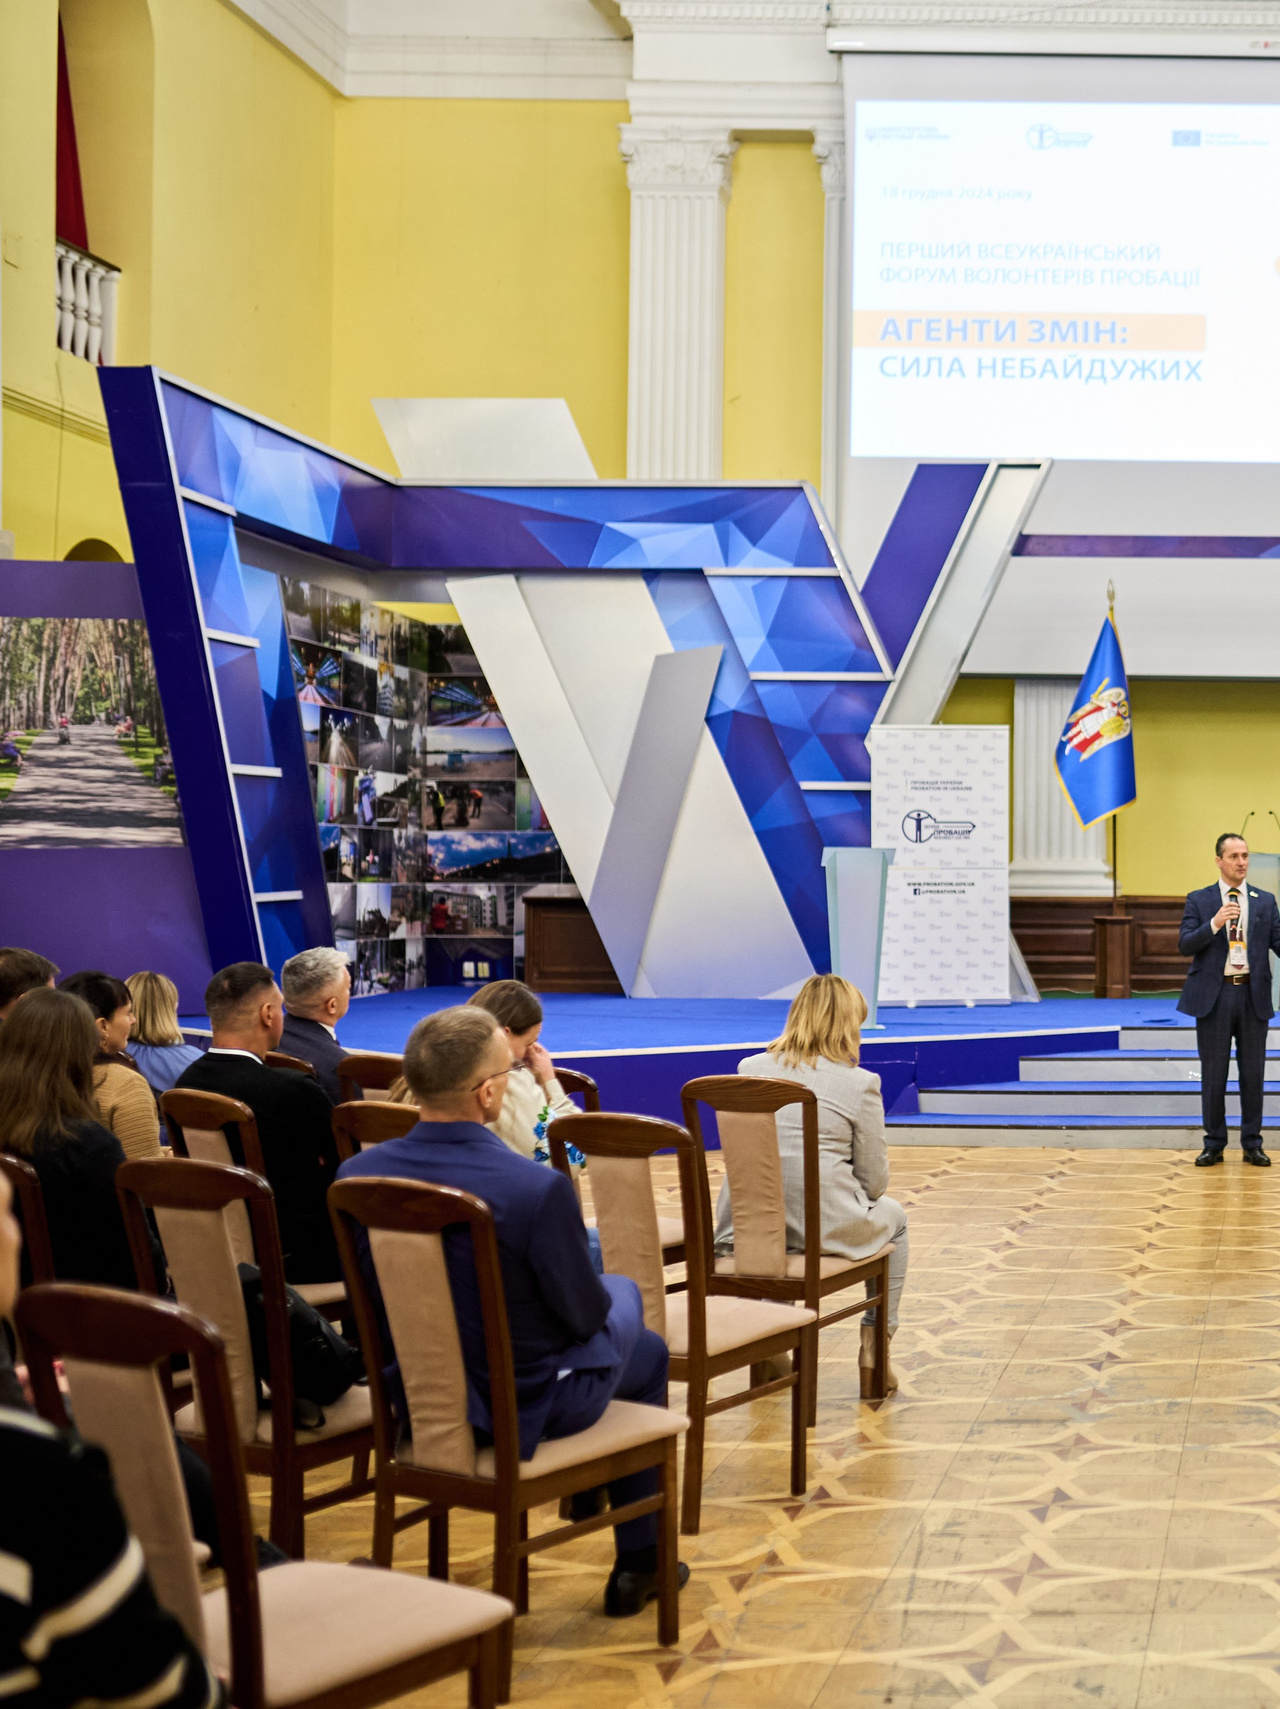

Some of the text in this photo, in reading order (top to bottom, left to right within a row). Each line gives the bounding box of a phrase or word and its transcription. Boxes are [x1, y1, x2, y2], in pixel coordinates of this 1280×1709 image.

[882, 186, 1033, 201] 18 грудня 2024 року
[880, 241, 1160, 262] ПЕРШИЙ ВСЕУКРАЇНСЬКИЙ
[880, 266, 1200, 288] ФОРУМ ВОЛОНТЕРІВ ПРОБАЦІЇ
[879, 318, 1128, 344] АГЕНТИ ЗМІН:
[879, 354, 1203, 385] СИЛА НЕБАЙДУЖИХ
